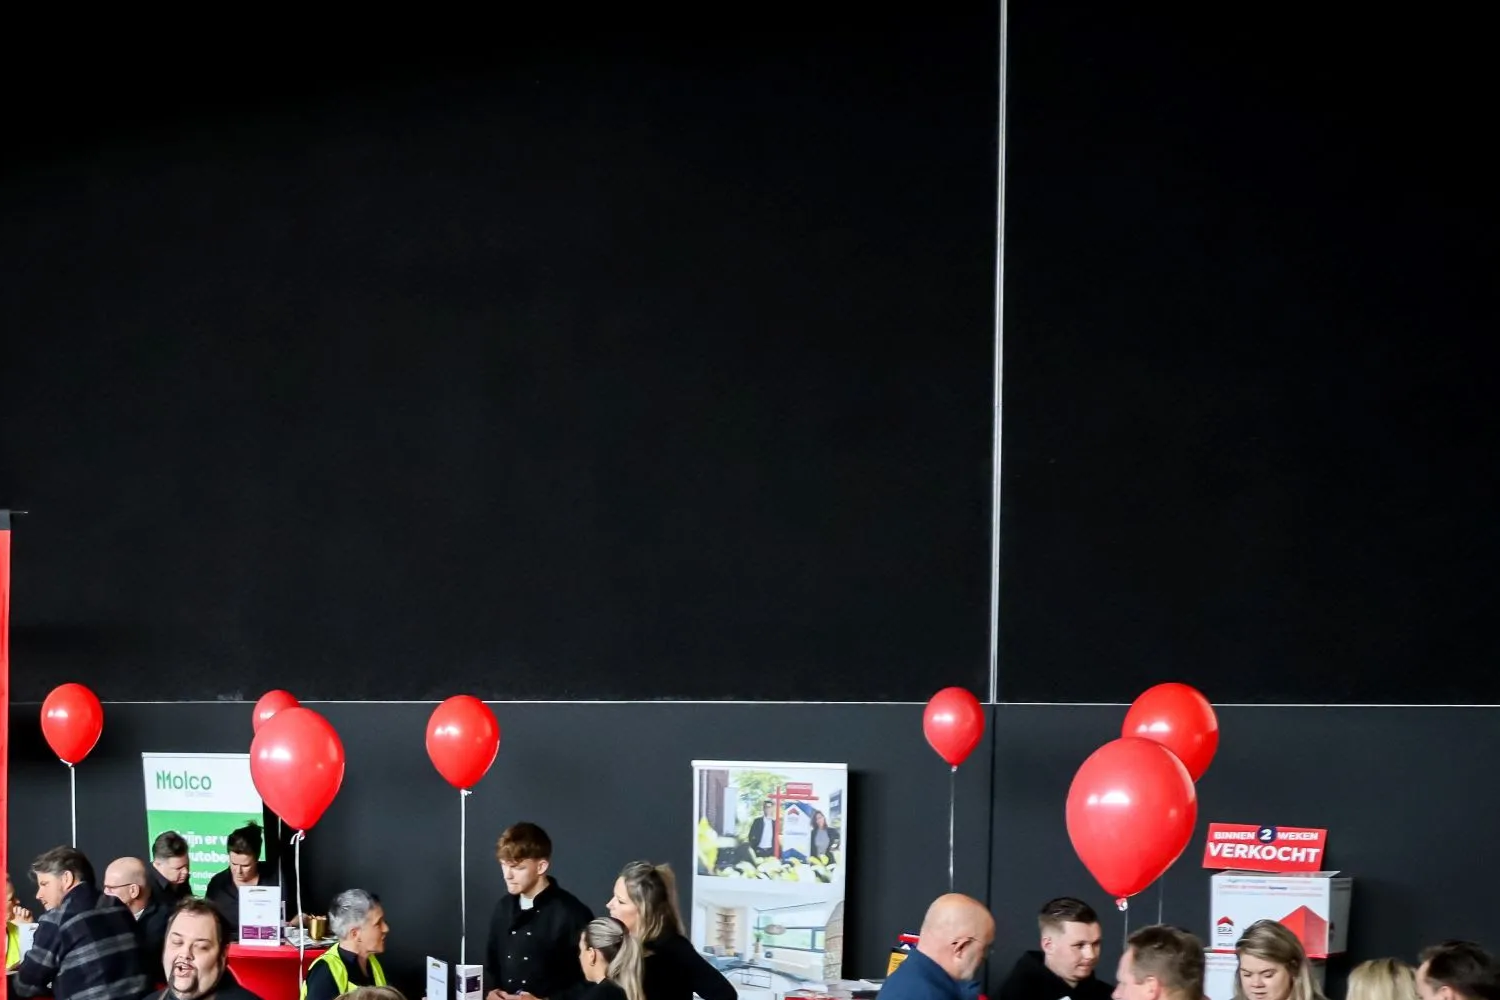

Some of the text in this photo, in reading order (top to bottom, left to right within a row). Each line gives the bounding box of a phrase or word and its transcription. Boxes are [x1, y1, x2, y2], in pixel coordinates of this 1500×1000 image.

[155, 769, 212, 791] Molco
[1213, 828, 1320, 841] BINNEN 2 WEKEN
[1208, 841, 1321, 864] VERKOCHT
